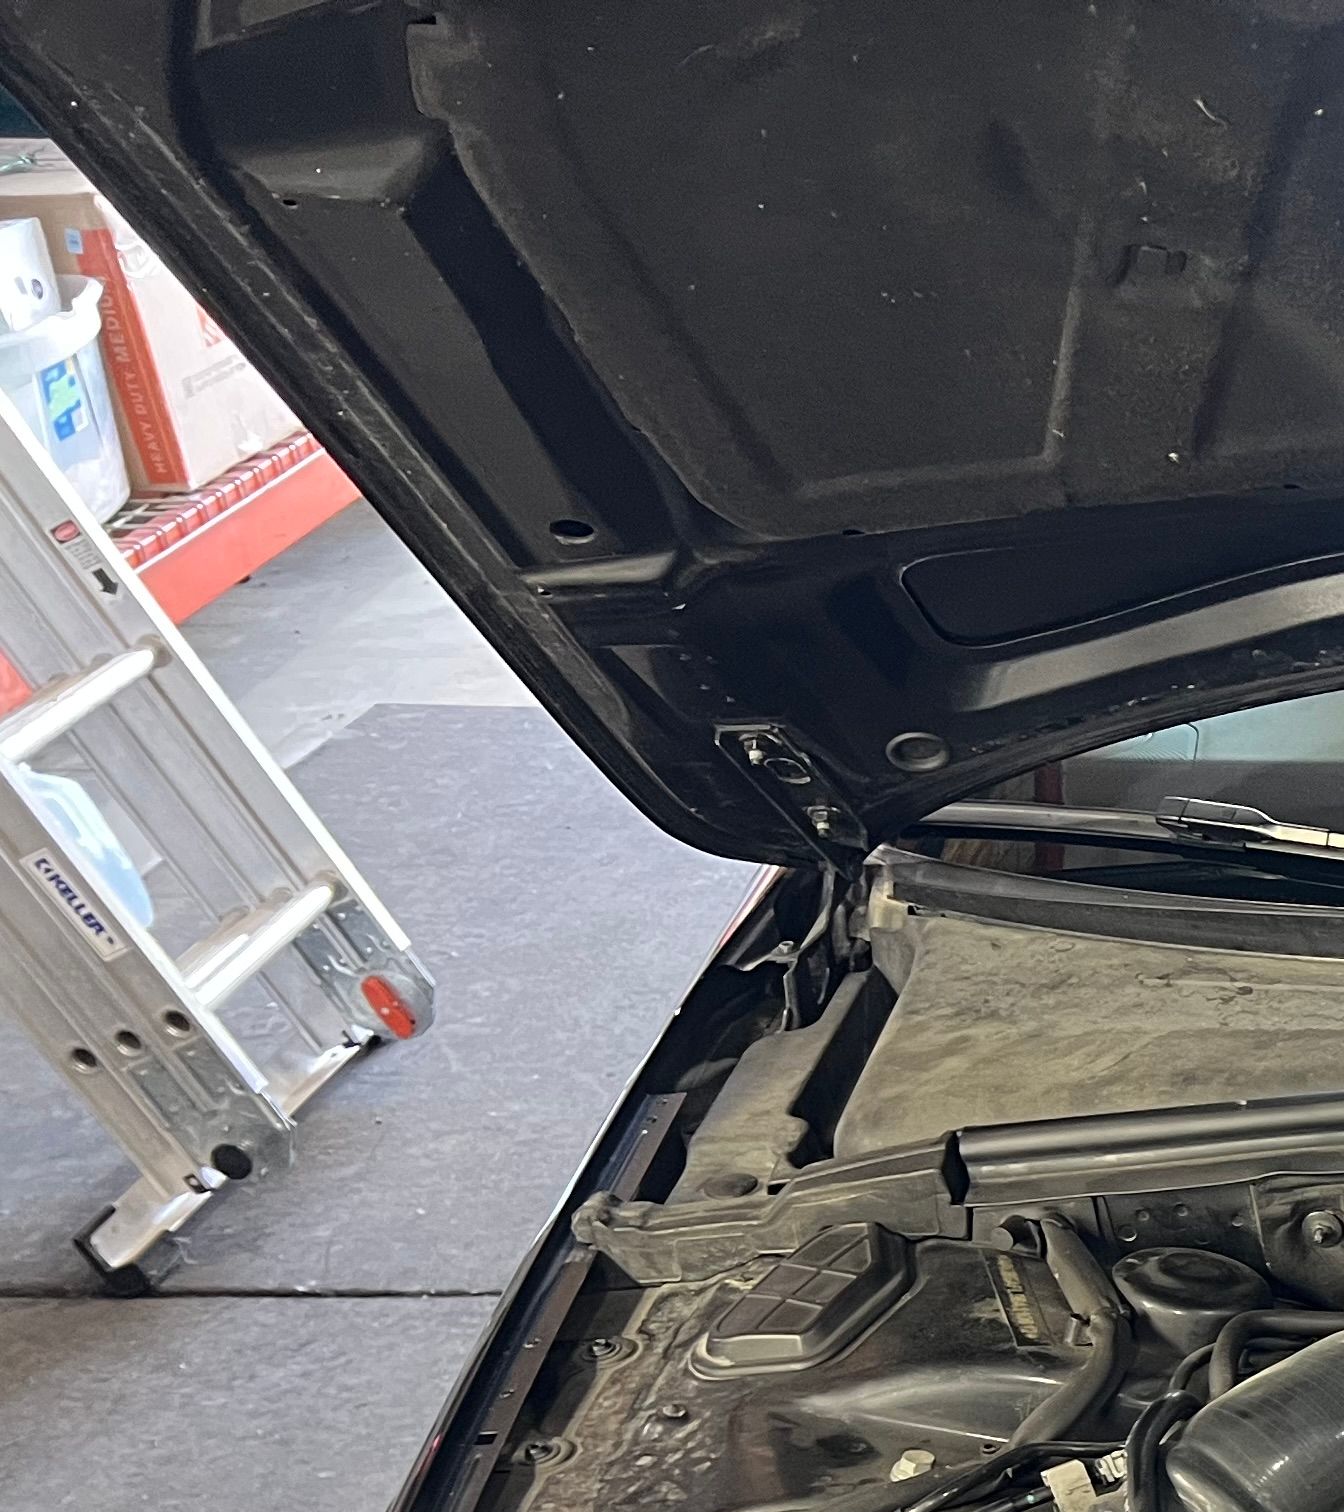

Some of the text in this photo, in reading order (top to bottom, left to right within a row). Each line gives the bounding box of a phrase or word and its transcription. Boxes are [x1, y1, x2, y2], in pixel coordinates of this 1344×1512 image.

[124, 371, 148, 415] DUTY
[138, 420, 168, 474] HEAVY
[48, 874, 107, 935] KELLER
